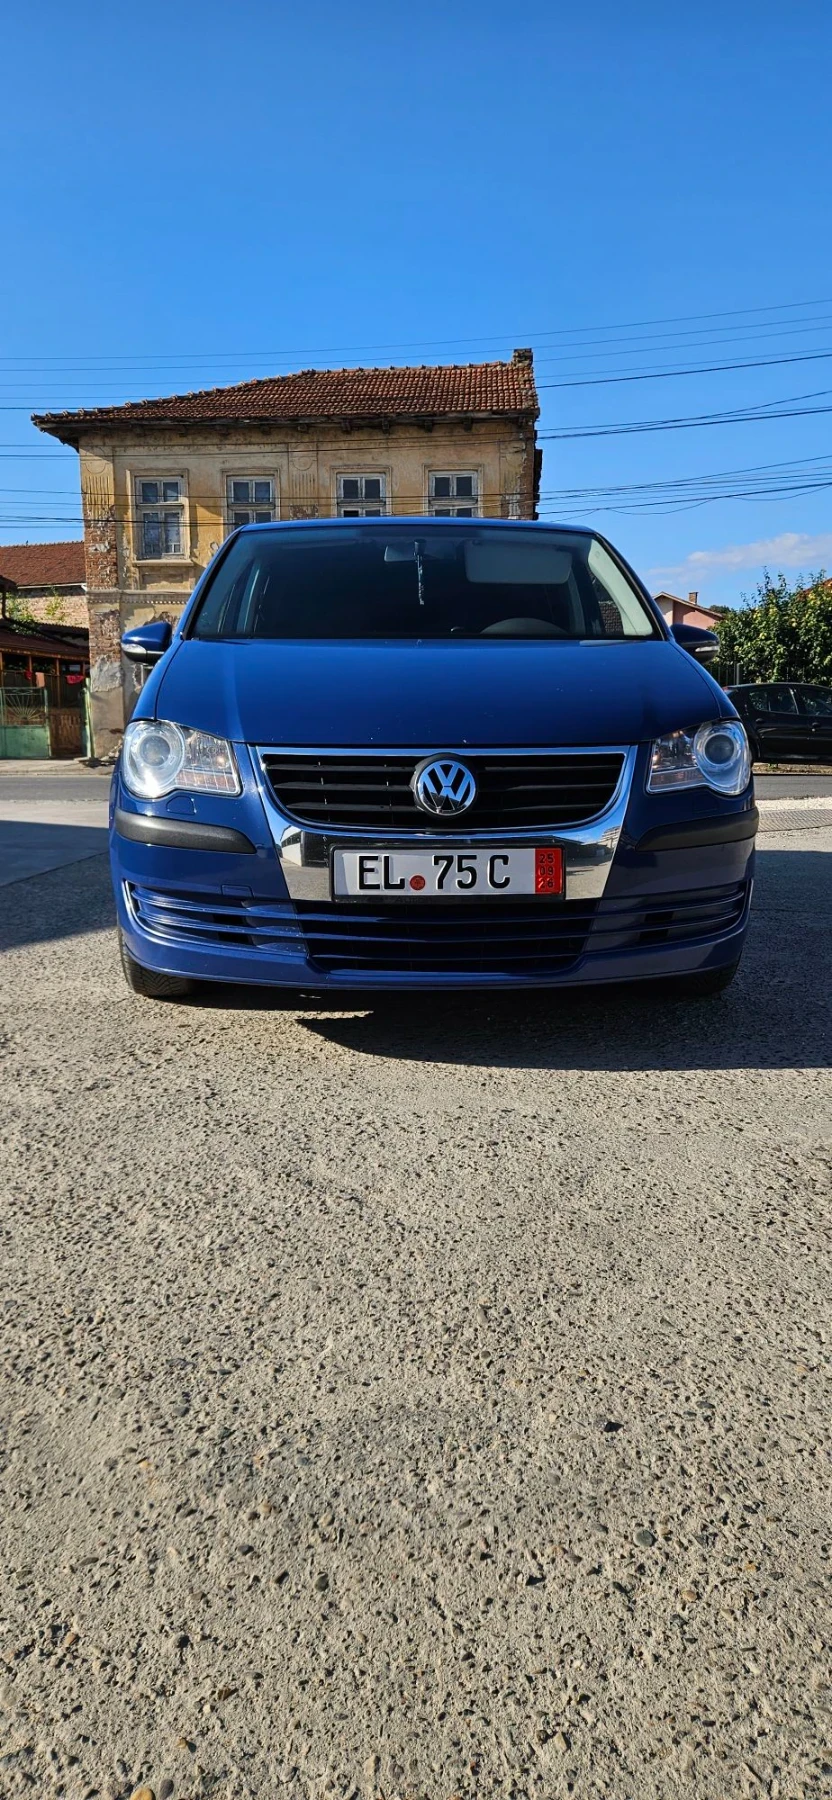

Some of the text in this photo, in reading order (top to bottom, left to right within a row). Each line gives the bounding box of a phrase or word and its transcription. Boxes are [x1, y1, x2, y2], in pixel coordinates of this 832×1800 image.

[539, 853, 554, 864] 25
[358, 854, 510, 890] EL 75 C
[539, 865, 554, 876] 09
[538, 878, 554, 888] 26
